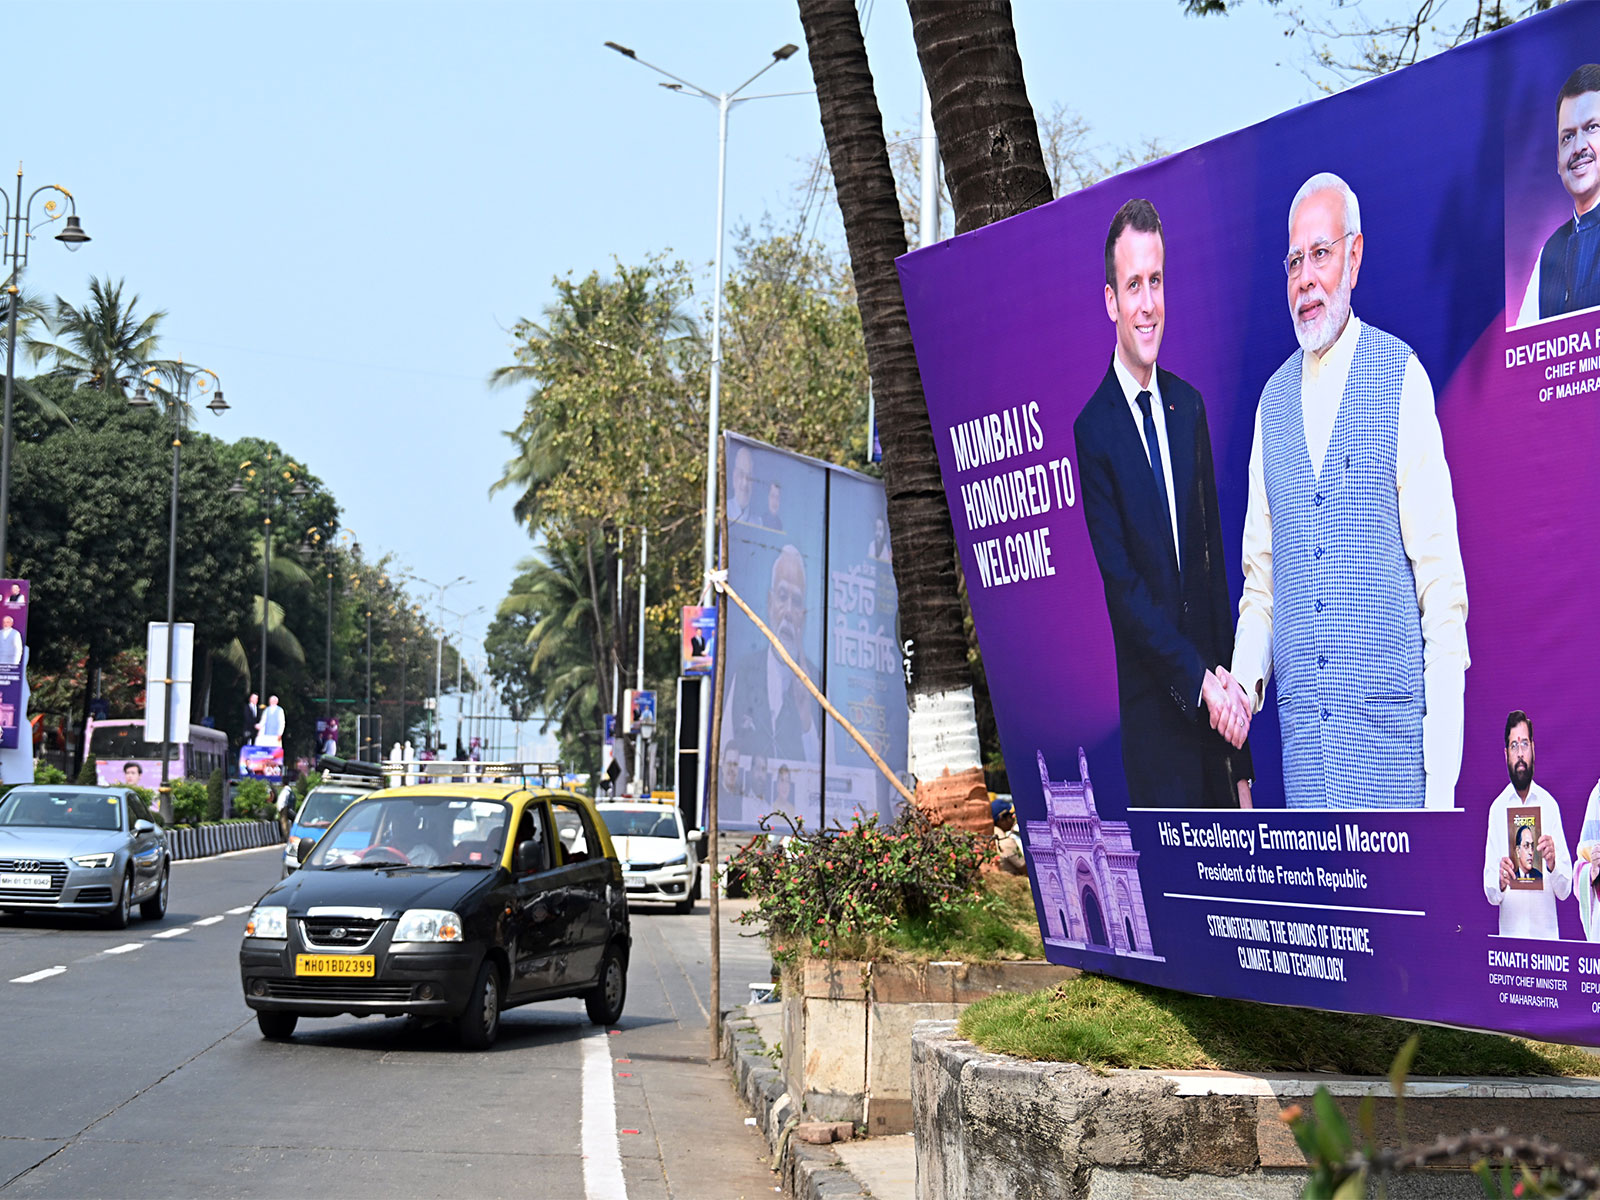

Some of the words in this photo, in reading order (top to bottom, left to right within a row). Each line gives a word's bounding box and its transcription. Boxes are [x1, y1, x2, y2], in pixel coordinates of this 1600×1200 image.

[1505, 331, 1592, 369] DEVENDRA
[1545, 361, 1576, 380] CHIEF
[1539, 387, 1554, 402] OF
[949, 406, 1024, 473] MUMBAI
[1021, 400, 1044, 453] IS
[960, 464, 1051, 531] HONOURED
[1048, 456, 1076, 509] TO
[972, 526, 1056, 588] WELCOME
[1157, 821, 1181, 846] His
[1181, 822, 1256, 856] Excellency
[1257, 823, 1342, 852] Emmanuel
[1344, 824, 1411, 853] Macron
[1196, 861, 1245, 883] President
[1245, 864, 1257, 883] of
[1257, 865, 1275, 884] the
[1275, 865, 1316, 887] French
[1316, 867, 1368, 892] Republic
[1206, 914, 1271, 943] STRENGTHENING
[1269, 920, 1288, 944] THE
[1286, 922, 1318, 948] BONDS
[1317, 924, 1330, 949] OF
[1329, 925, 1374, 956] DEFENCE,
[304, 959, 372, 973] MH01BD2399
[1237, 946, 1274, 972] CLIMATE
[1272, 950, 1291, 975] AND
[1289, 952, 1348, 982] TECHNOLOGY.
[1488, 950, 1529, 969] EKNATH
[1530, 953, 1570, 973] SHINDE
[1488, 973, 1515, 987] DEPUTY
[1515, 976, 1535, 988] CHIEF
[1535, 977, 1568, 991] MINISTER
[1499, 992, 1509, 1003] OF
[1509, 993, 1559, 1009] MAHARASHTRA
